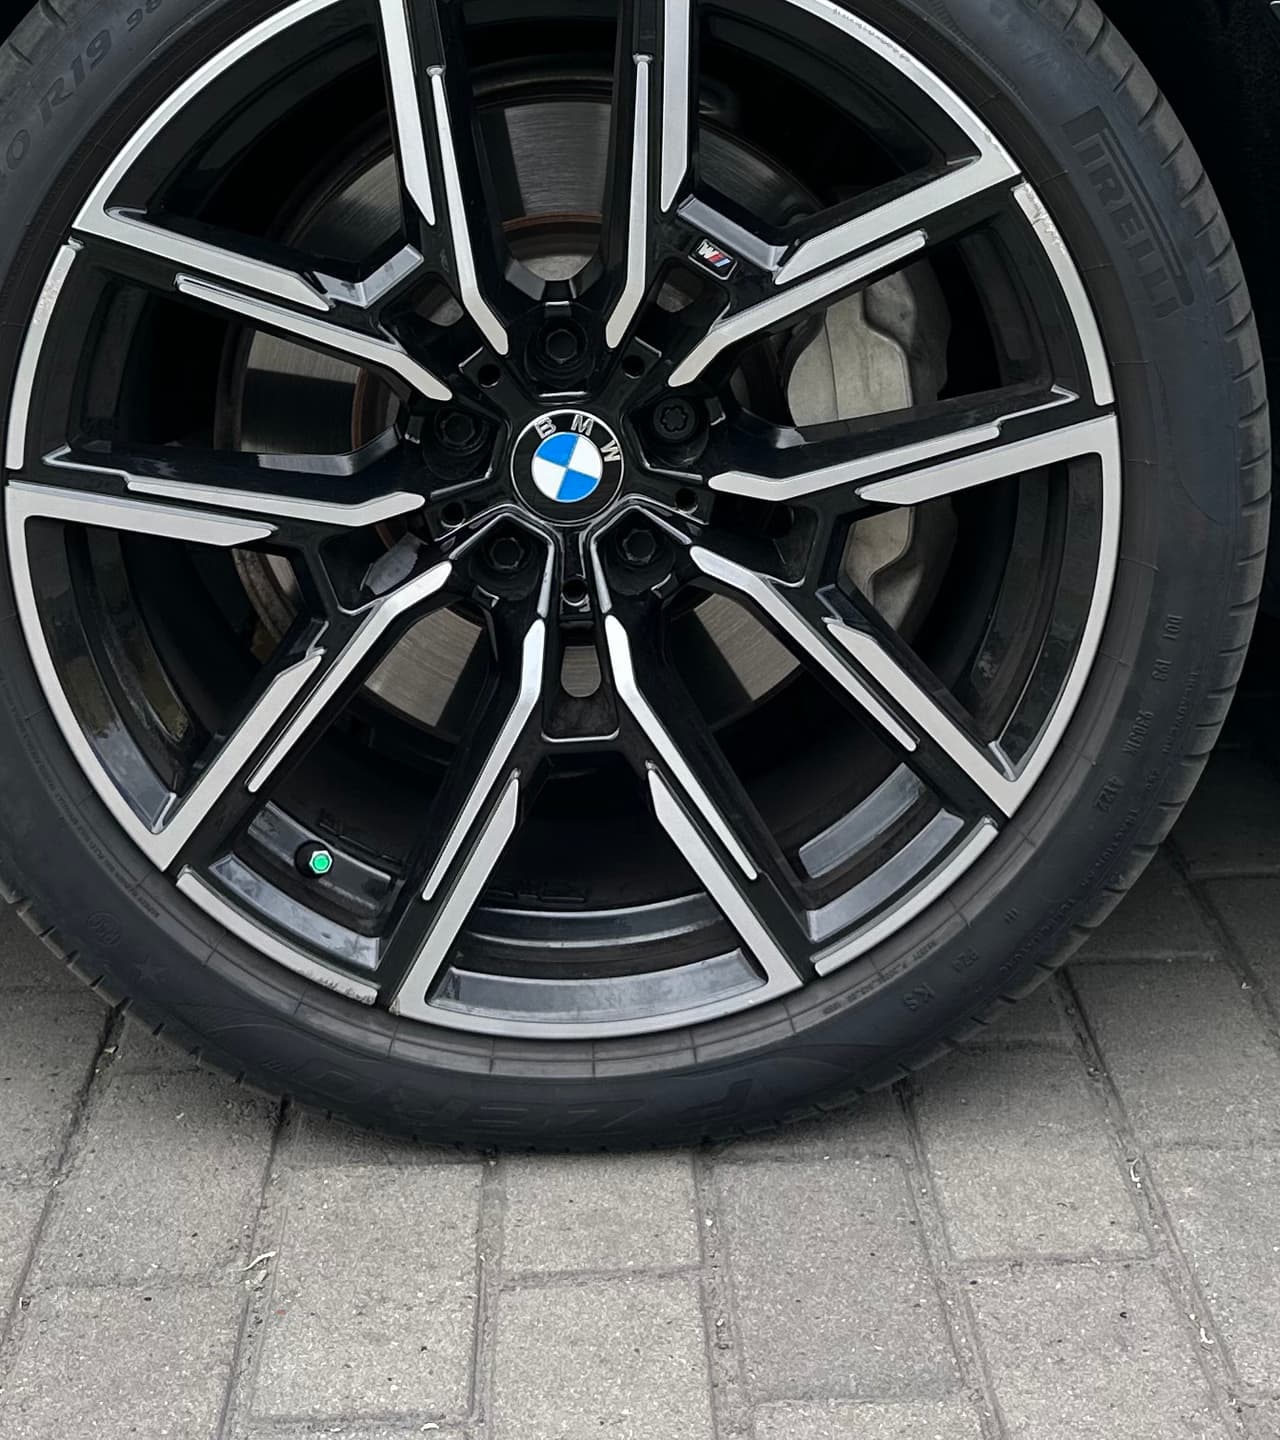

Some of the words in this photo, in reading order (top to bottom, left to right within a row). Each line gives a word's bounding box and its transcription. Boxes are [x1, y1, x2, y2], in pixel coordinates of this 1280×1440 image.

[38, 28, 113, 128] R19
[1061, 105, 1195, 320] PIRELLI
[534, 414, 622, 463] BMW
